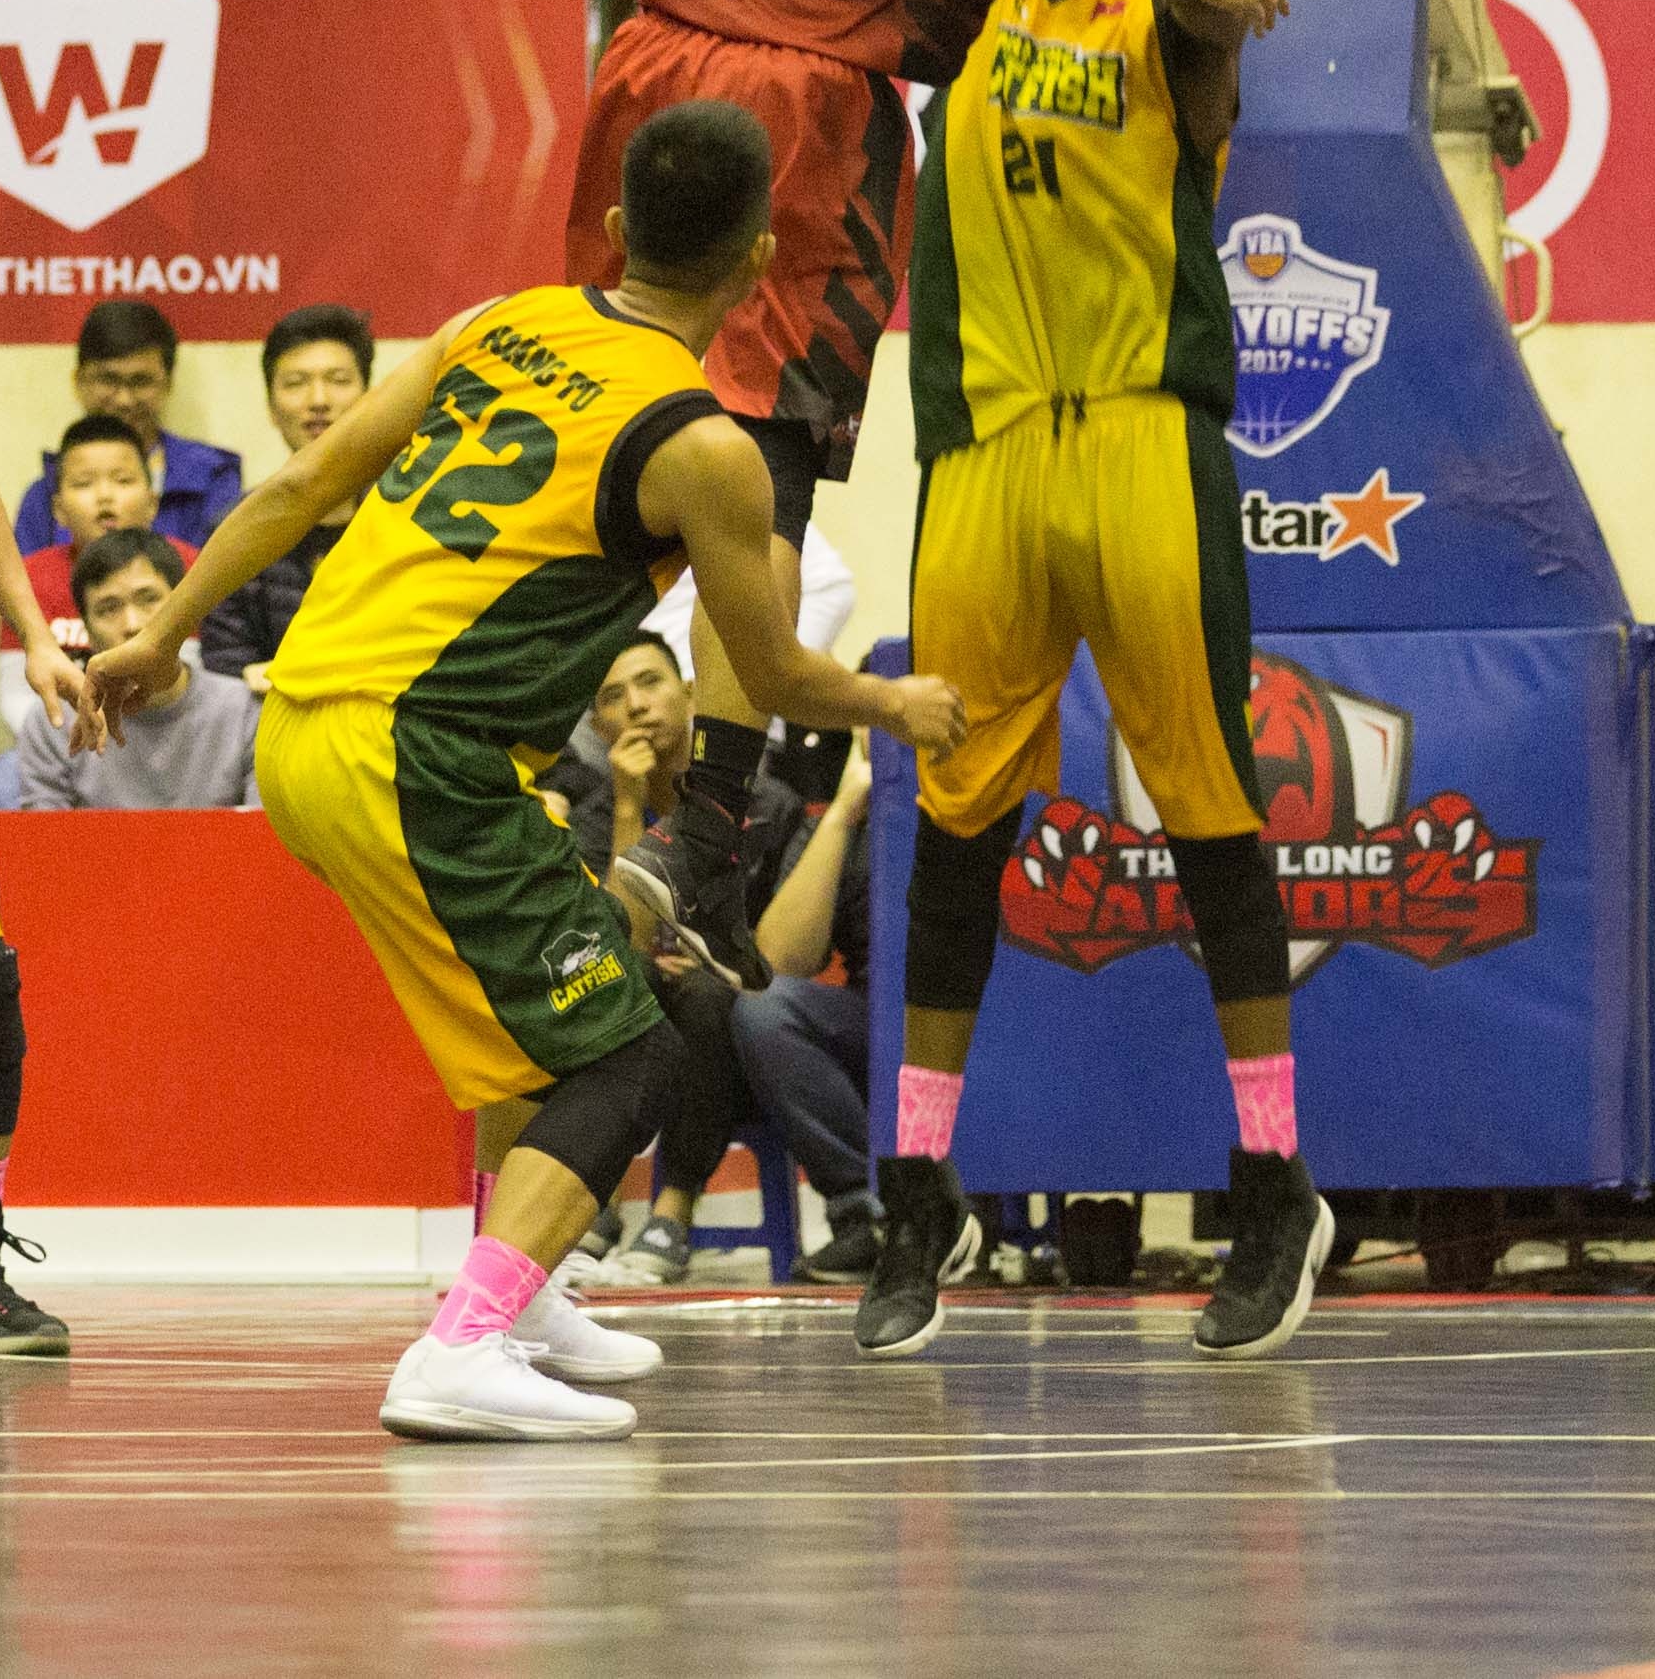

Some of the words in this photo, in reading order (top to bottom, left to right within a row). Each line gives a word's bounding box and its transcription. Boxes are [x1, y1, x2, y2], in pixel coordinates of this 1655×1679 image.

[1244, 231, 1286, 255] VBA
[1235, 305, 1375, 357] YOFFS
[1238, 349, 1293, 374] 2017
[549, 948, 625, 1016] CATFISH
